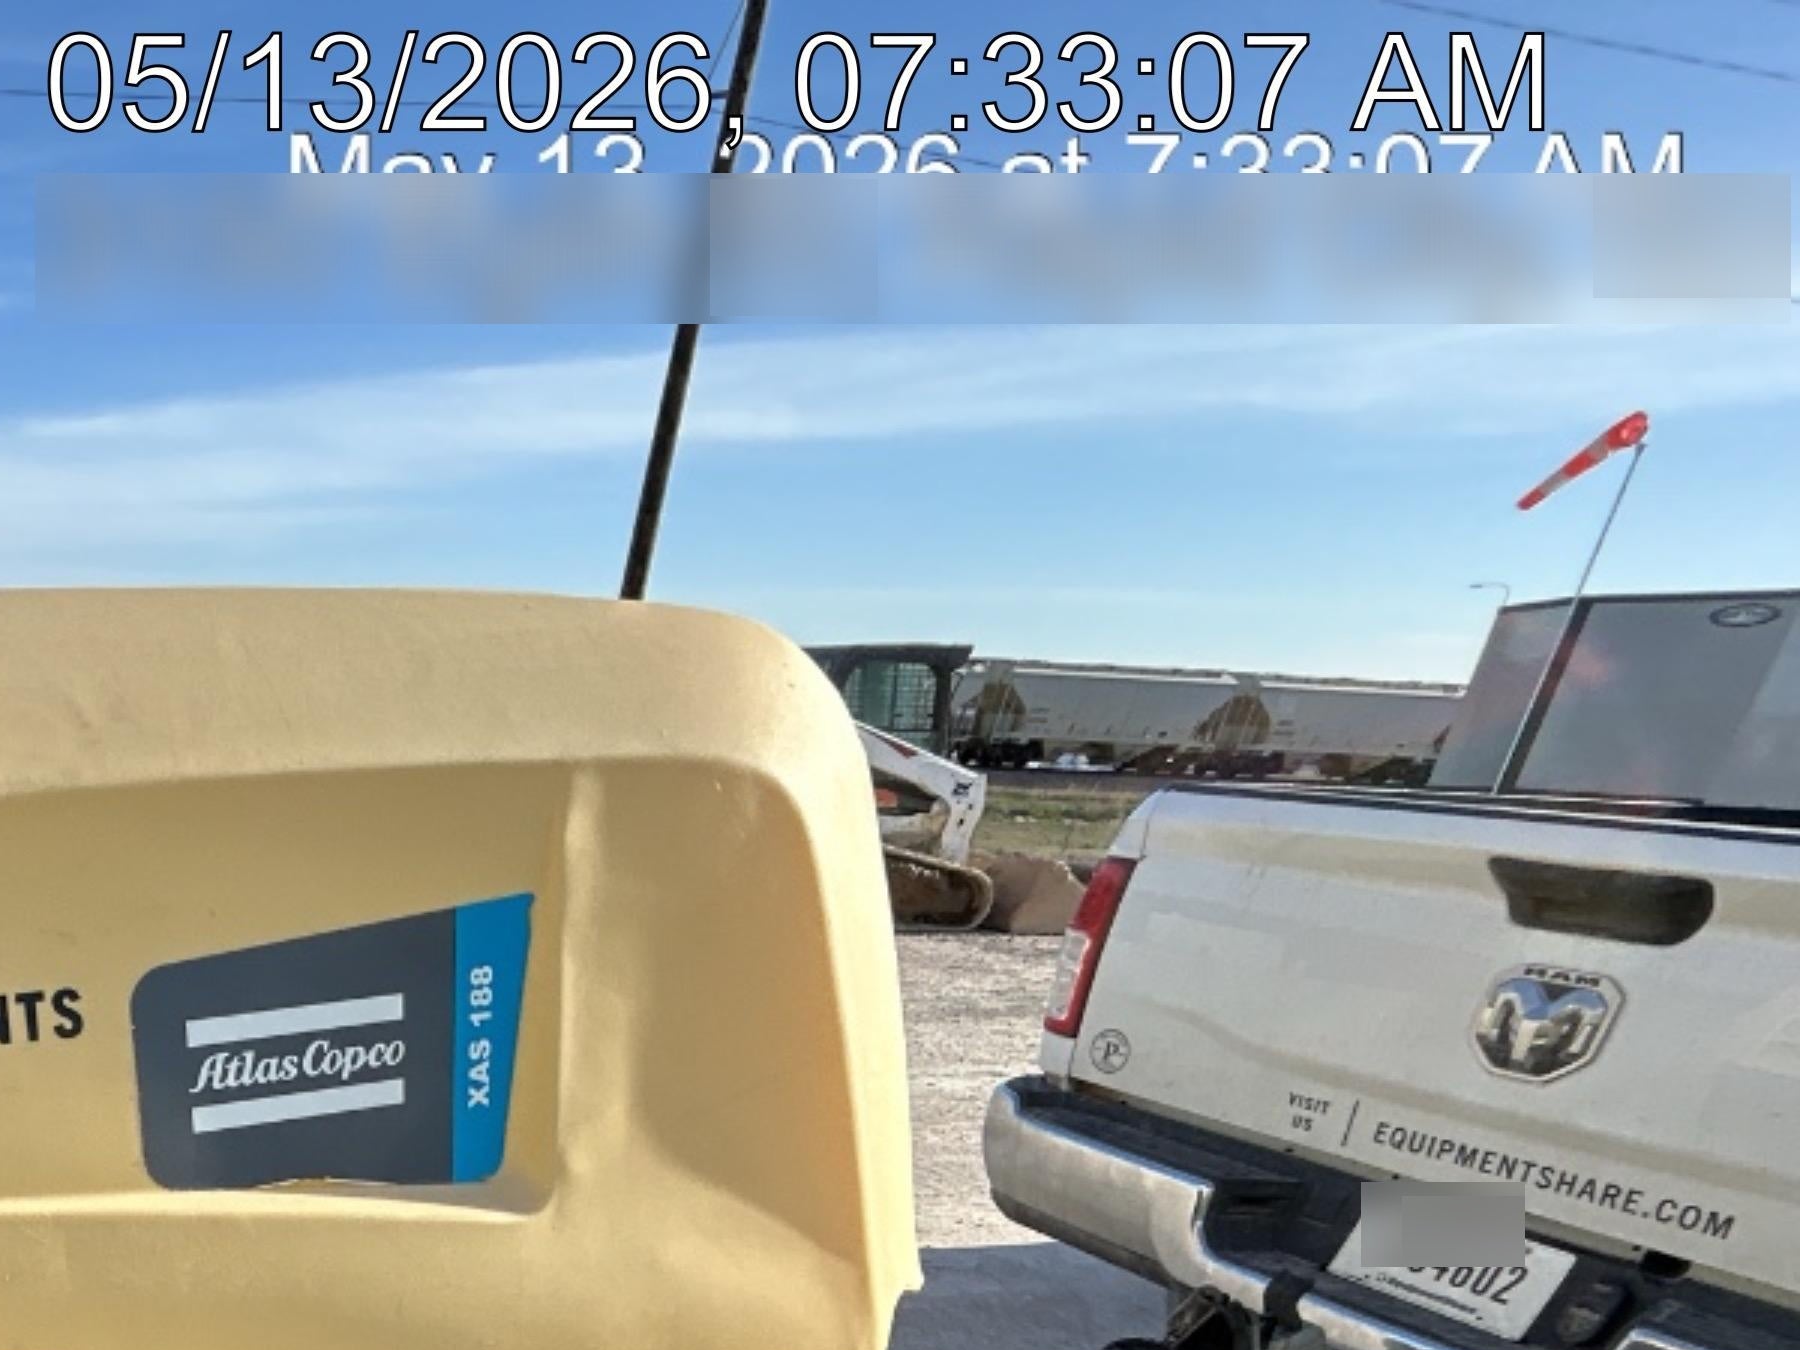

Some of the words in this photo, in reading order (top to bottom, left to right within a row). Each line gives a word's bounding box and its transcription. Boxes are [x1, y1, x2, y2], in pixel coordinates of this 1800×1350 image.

[469, 965, 493, 1028] 188
[189, 1049, 298, 1094] Atlas
[302, 1039, 405, 1080] Copco
[466, 1039, 492, 1109] XAS
[1288, 1091, 1330, 1115] VISIT
[1291, 1114, 1313, 1132] US
[1373, 1121, 1735, 1240] EQUIPMENTSHARE.COM
